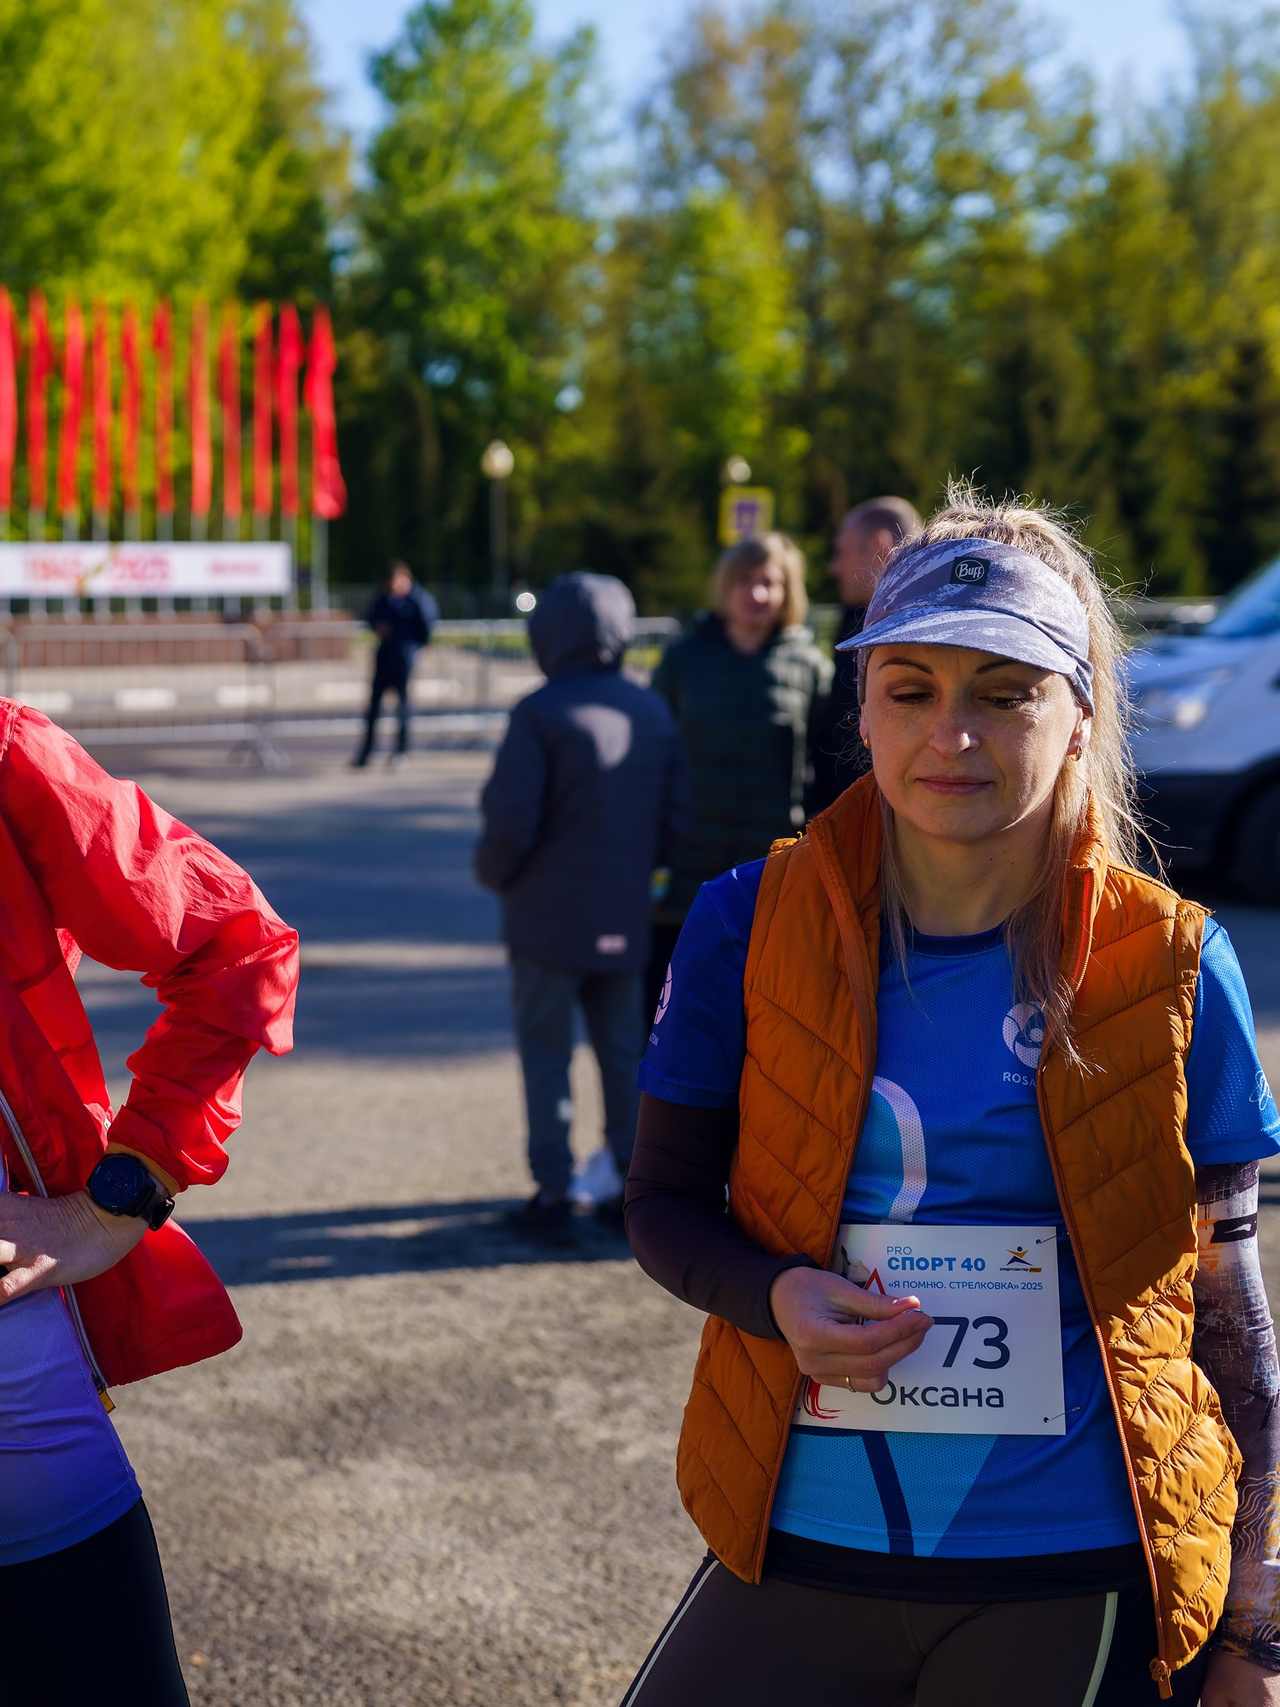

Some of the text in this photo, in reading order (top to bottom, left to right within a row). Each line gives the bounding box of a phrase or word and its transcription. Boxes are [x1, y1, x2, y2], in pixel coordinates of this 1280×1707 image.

[959, 563, 983, 578] Buff
[886, 1246, 912, 1255] PRO
[887, 1257, 986, 1272] СПОРТ 40
[888, 1281, 1043, 1290] «Я ПОМНЮ. СТРЕЛКОВКА» 2025
[931, 1315, 1011, 1370] 73
[870, 1380, 1005, 1408] Оксана
